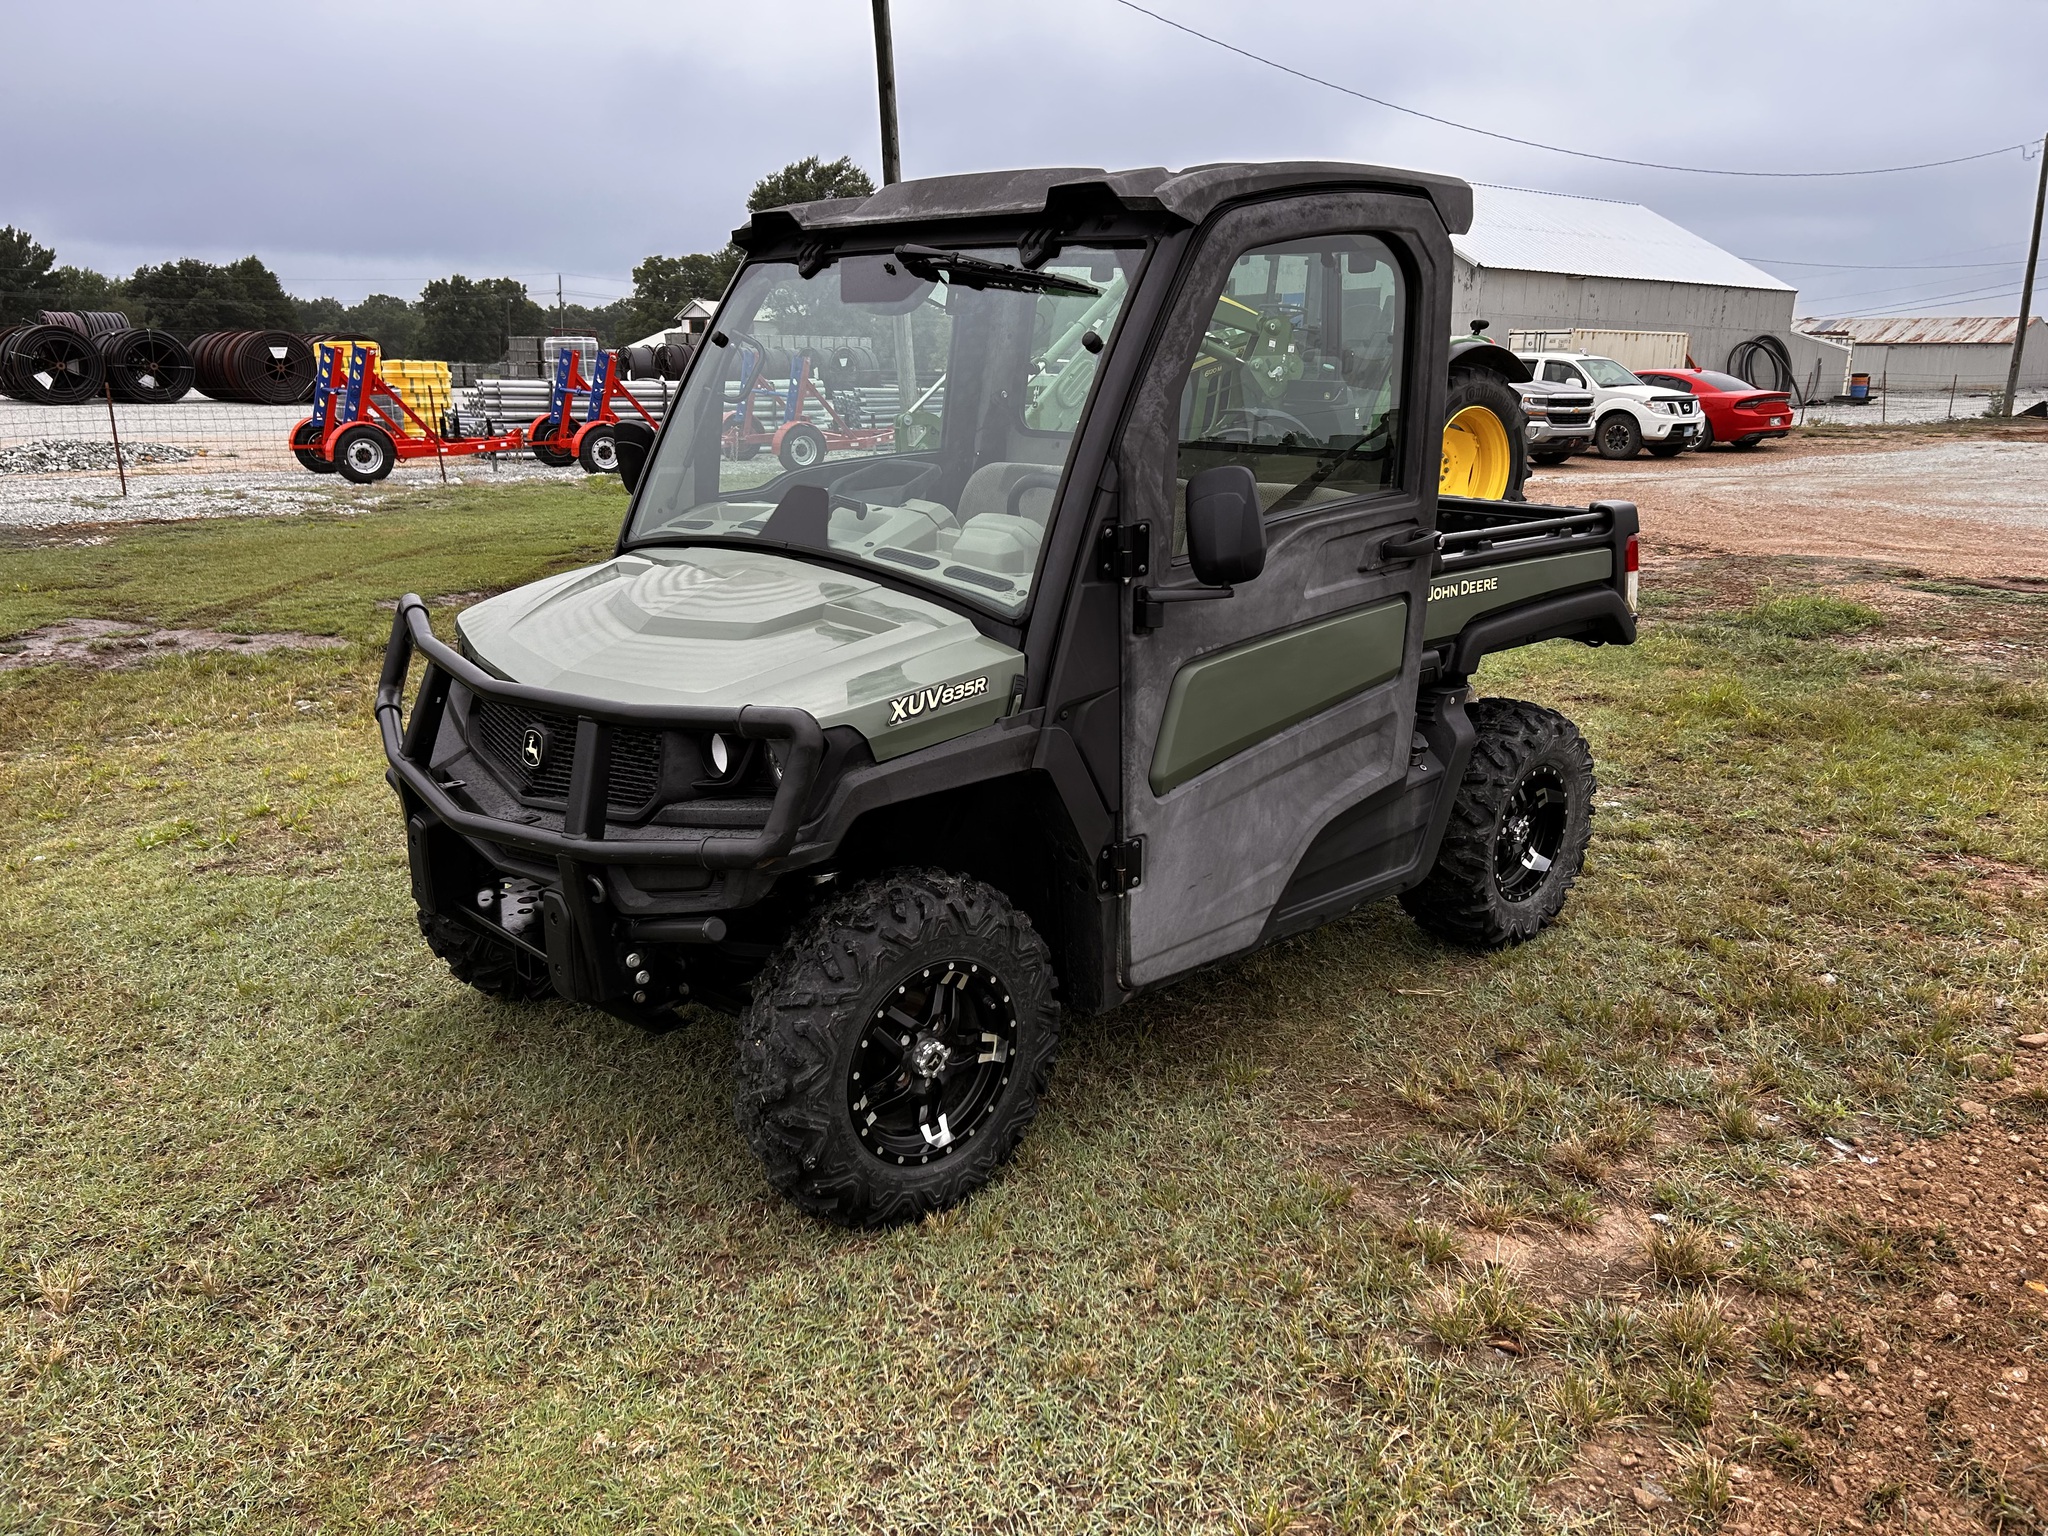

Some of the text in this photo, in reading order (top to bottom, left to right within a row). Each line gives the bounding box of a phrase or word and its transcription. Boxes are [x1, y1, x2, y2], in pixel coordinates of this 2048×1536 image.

[1427, 577, 1498, 602] JOHN DEERE
[889, 676, 987, 724] XUV835R
